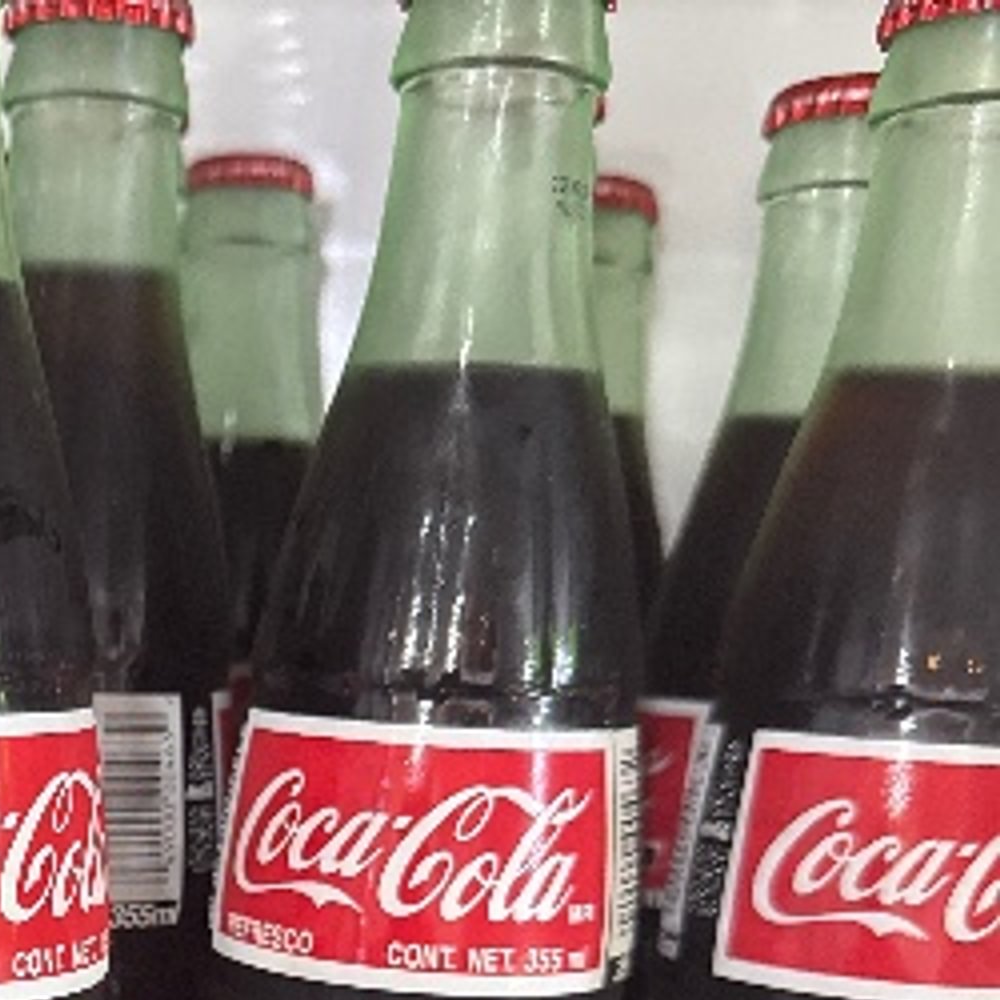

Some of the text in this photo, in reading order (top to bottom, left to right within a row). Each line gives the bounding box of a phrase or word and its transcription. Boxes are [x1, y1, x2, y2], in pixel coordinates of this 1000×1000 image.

[233, 768, 592, 922] Coca-Cola
[227, 911, 315, 955] REFRESCO
[524, 946, 564, 975] 355
